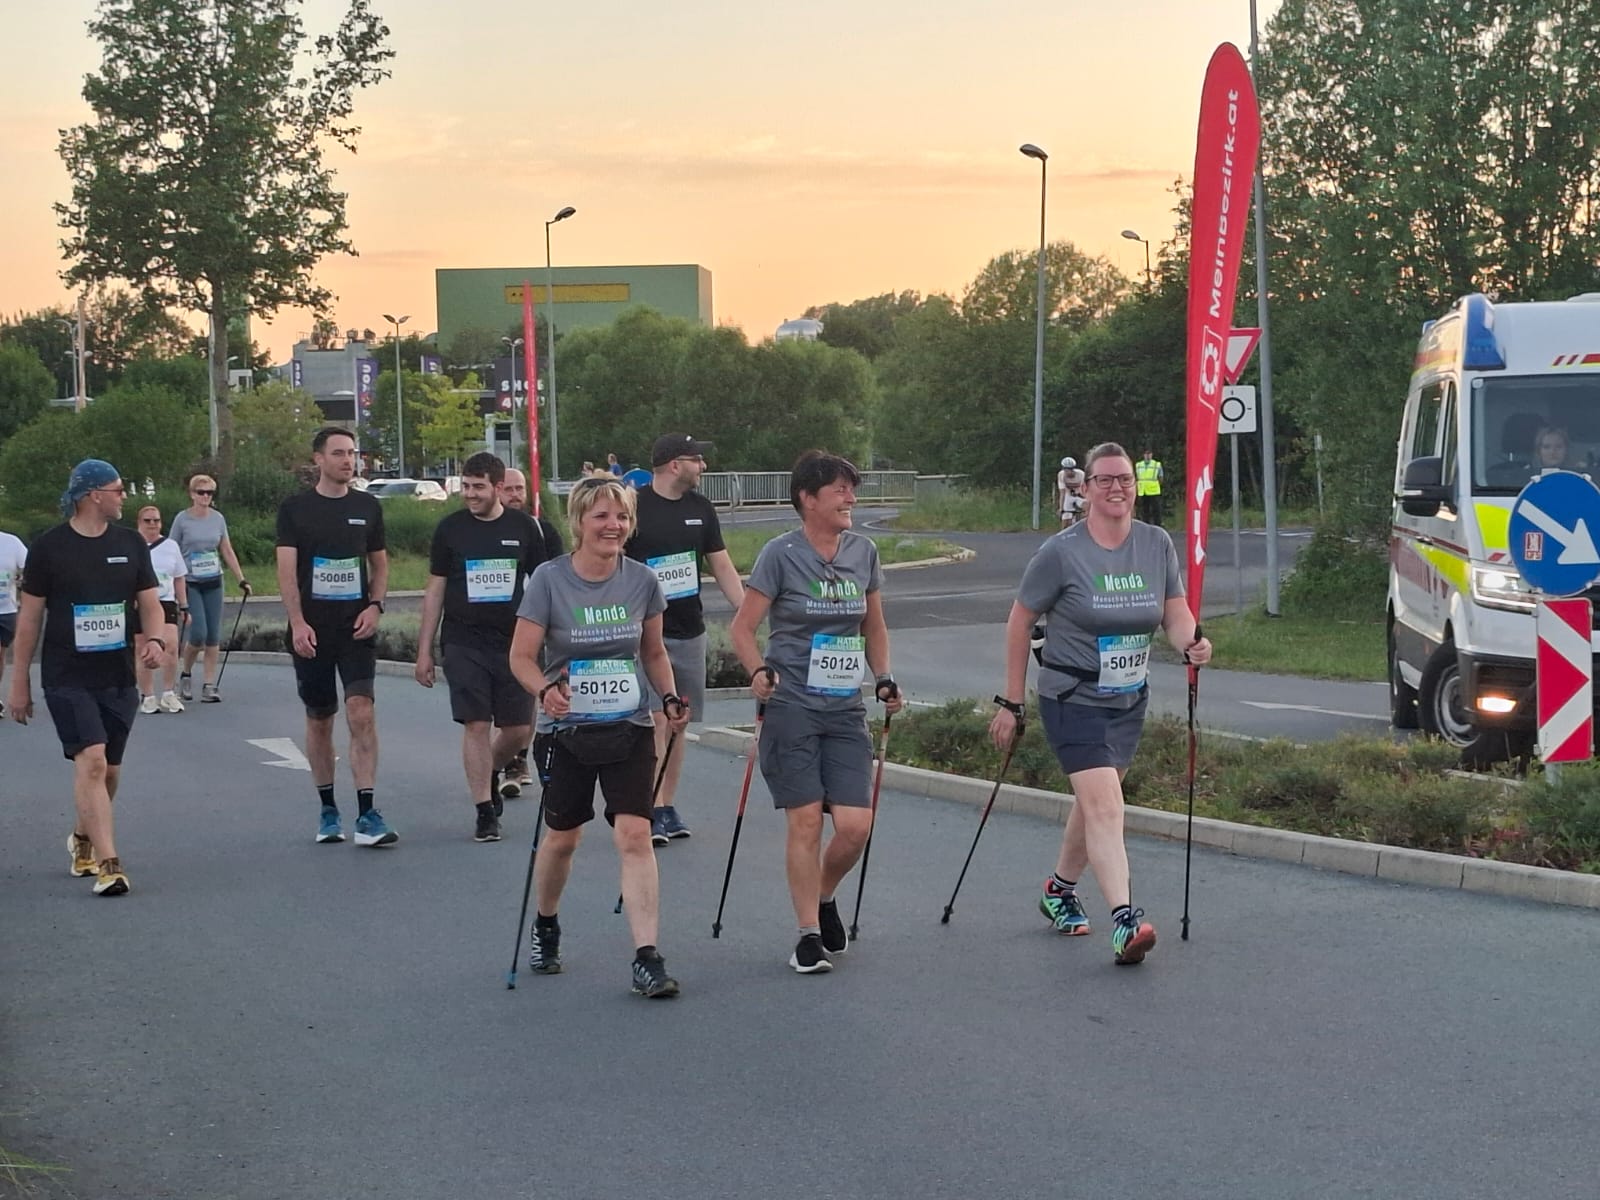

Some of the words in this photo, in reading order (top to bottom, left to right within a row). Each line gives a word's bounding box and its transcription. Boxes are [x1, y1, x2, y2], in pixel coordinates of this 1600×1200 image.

[502, 395, 546, 409] 4YU
[320, 572, 355, 583] 5008B
[475, 573, 511, 584] 5008E
[658, 566, 692, 582] 5008C
[1103, 572, 1144, 593] Menda
[584, 604, 627, 625] Menda
[83, 618, 121, 632] 5008A
[820, 655, 860, 671] 5012A
[580, 679, 630, 695] 5012C
